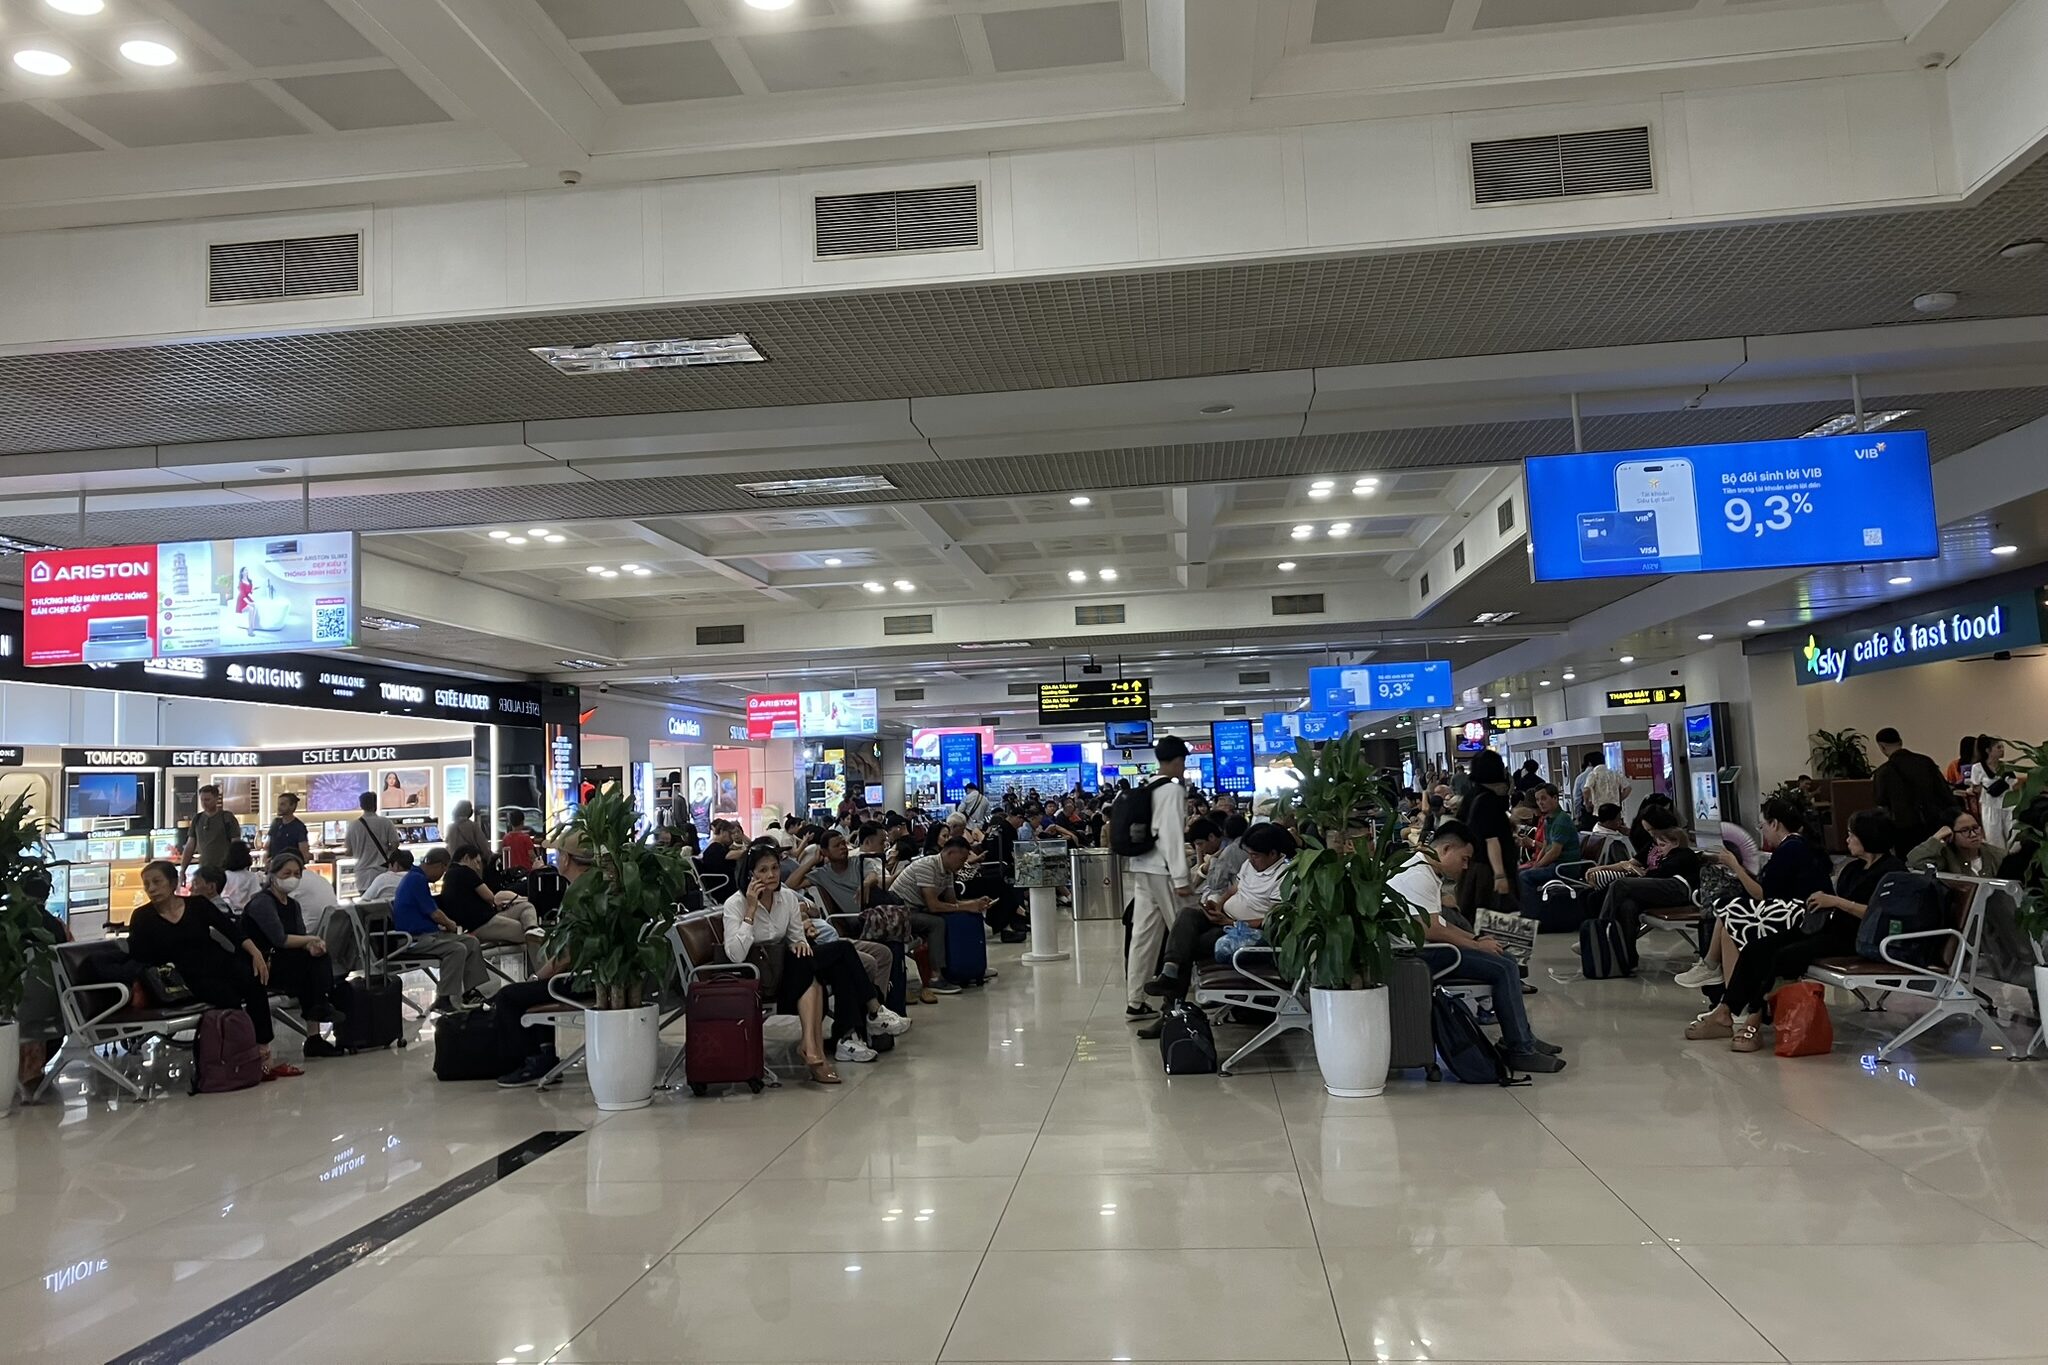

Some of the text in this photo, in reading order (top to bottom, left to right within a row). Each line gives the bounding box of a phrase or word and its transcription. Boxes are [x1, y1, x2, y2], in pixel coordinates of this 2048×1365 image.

[1854, 448, 1878, 460] VIB
[1722, 468, 1822, 486] Bộ đôi sinh lời VIB
[1724, 492, 1813, 538] 9,3%
[1640, 546, 1658, 554] VISA
[54, 561, 150, 581] ARISTON
[1818, 606, 2001, 683] sky cafe & fast food
[167, 657, 204, 674] SERIES
[246, 665, 302, 689] ORIGINS
[319, 672, 366, 688] JO MALONE
[379, 682, 424, 703] TOM FORD
[1378, 682, 1411, 699] 9,3%
[1609, 690, 1649, 700] THANG MÁY
[459, 692, 490, 710] LAUDER
[758, 699, 797, 708] ARISTON
[84, 751, 147, 765] TOM FORD
[210, 752, 258, 766] LAUDER
[343, 747, 396, 762] LAUDER
